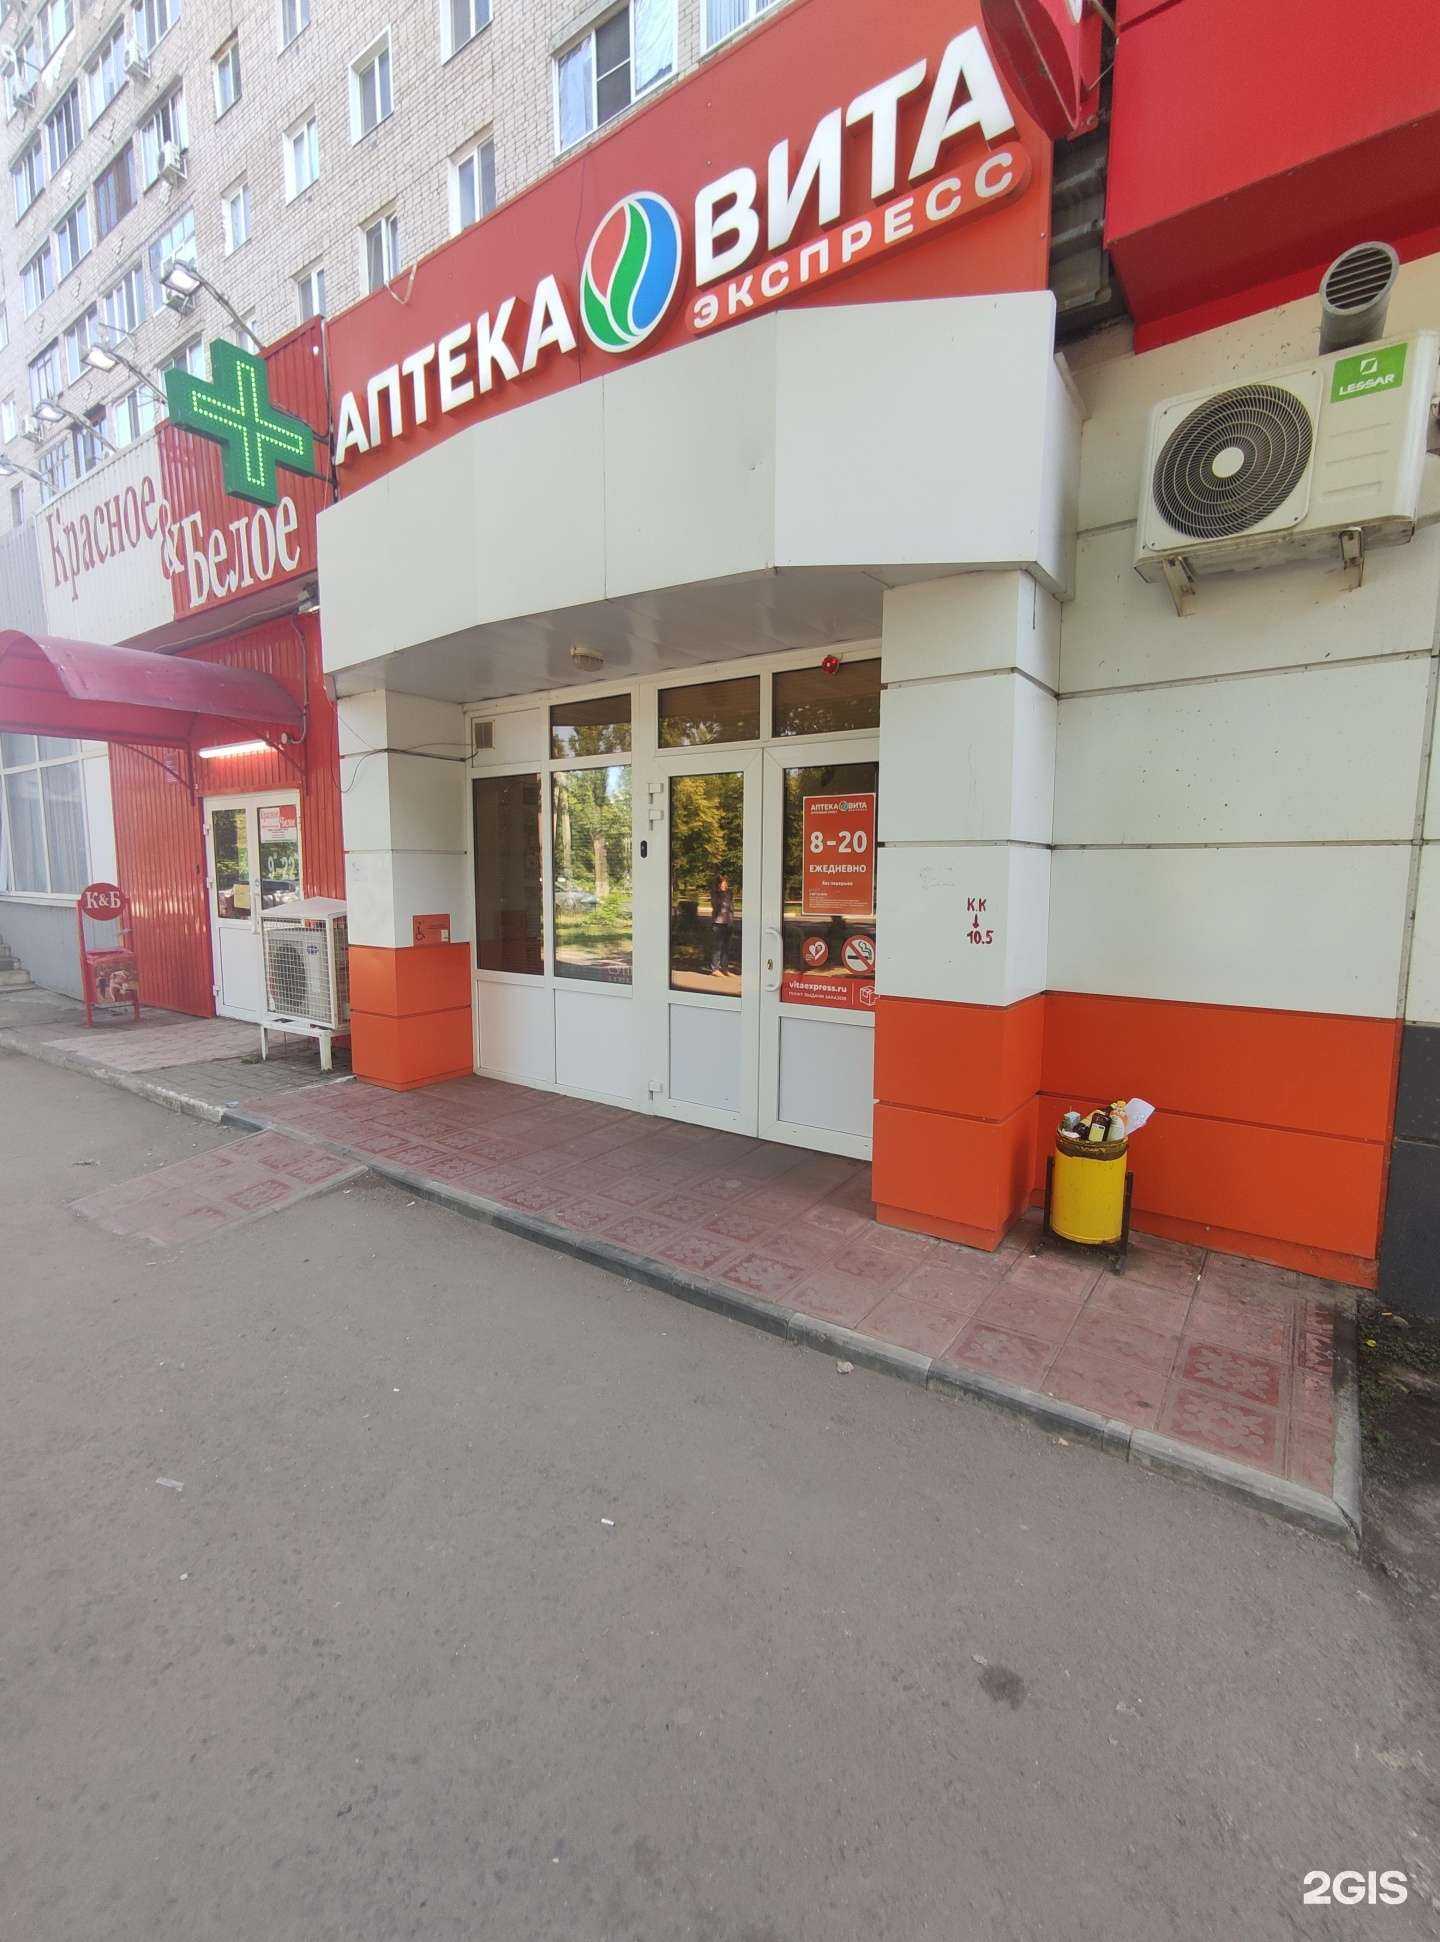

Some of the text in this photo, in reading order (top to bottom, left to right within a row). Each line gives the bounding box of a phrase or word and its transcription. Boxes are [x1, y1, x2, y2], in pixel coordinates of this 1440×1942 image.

[335, 25, 1016, 466] АПТЕКА ВИТА
[693, 152, 1013, 329] ЭКСПРЕСС
[1339, 373, 1395, 396] LESSAR
[45, 475, 301, 609] Красное & Белое
[810, 803, 840, 812] АПТЕКА
[810, 830, 868, 854] 8-20
[809, 864, 867, 874] ЕЖЕДНЕВНО
[85, 891, 121, 909] К&Б
[966, 930, 994, 945] 10.5
[789, 981, 848, 993] vitaexpress.ru
